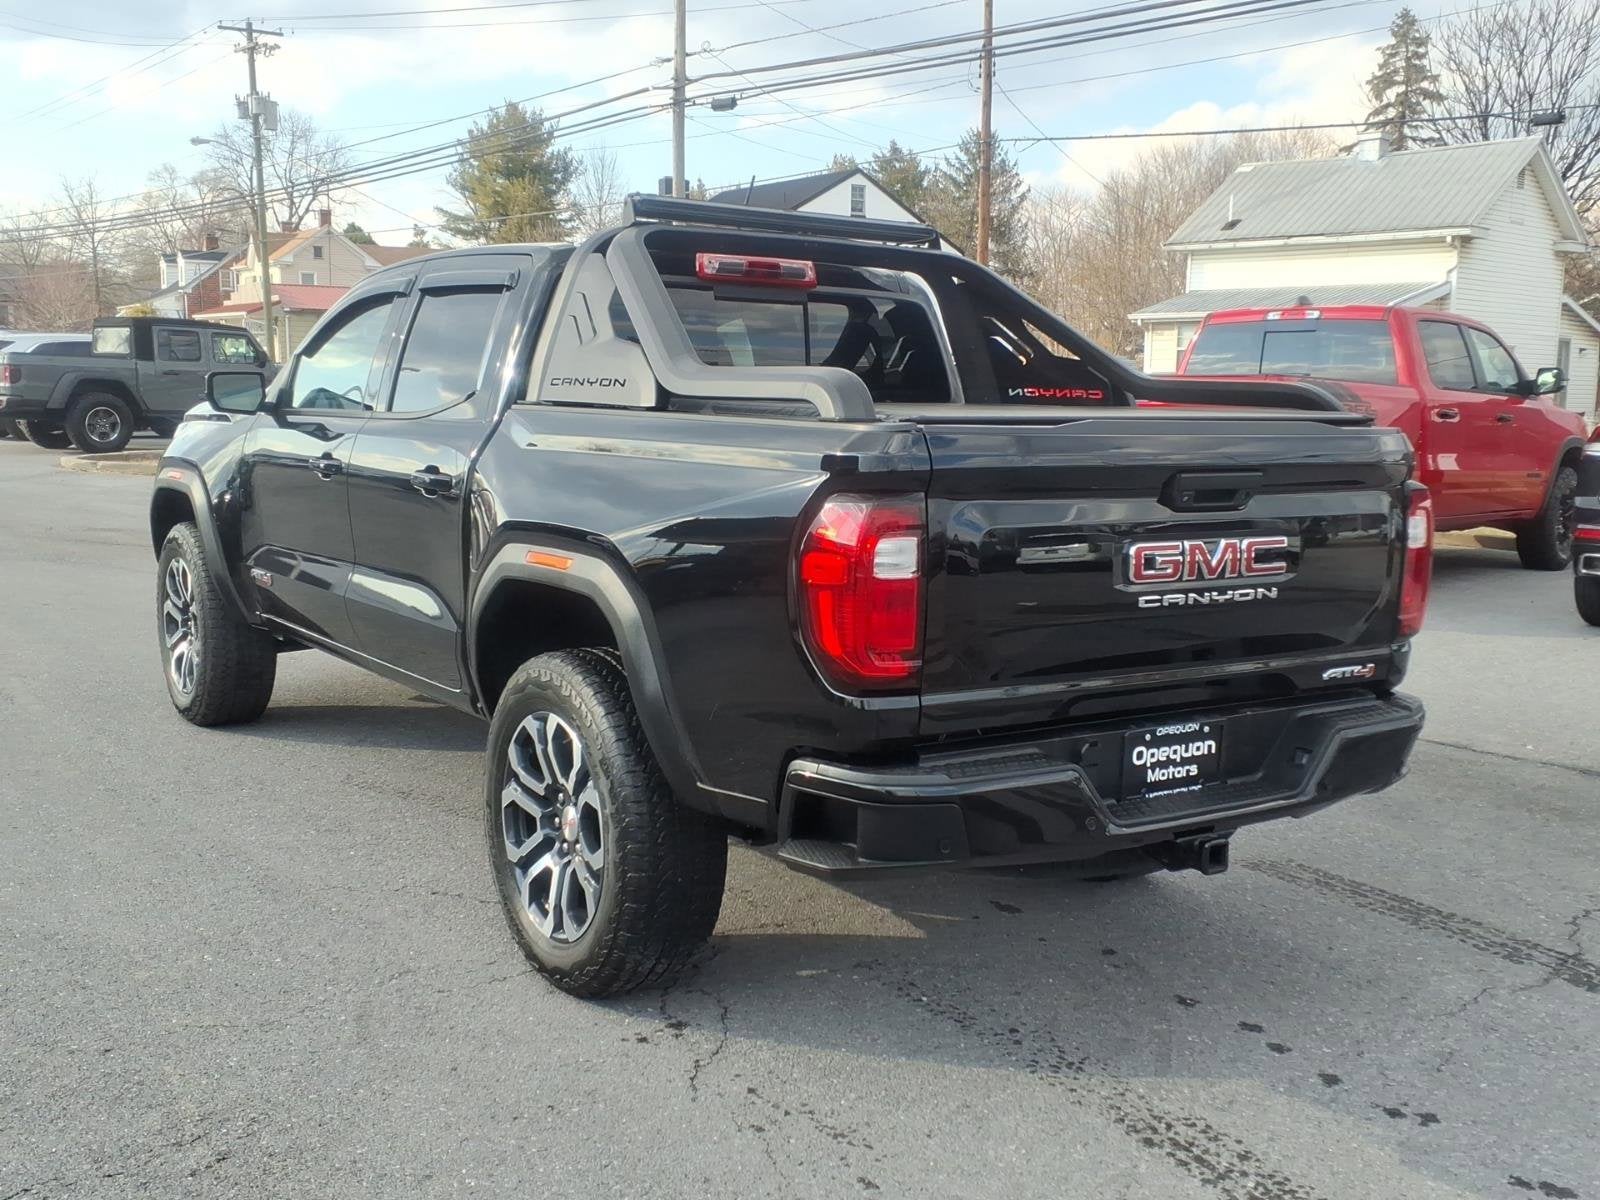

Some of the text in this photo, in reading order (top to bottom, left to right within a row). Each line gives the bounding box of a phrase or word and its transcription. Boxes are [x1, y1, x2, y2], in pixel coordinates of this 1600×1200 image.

[550, 377, 627, 387] CANYON
[1129, 536, 1288, 584] GMC
[1138, 586, 1279, 608] CANYON
[1322, 663, 1376, 680] AT4
[1156, 723, 1200, 736] OPEQUON
[1132, 740, 1216, 767] Opequon
[1147, 764, 1199, 783] Motors
